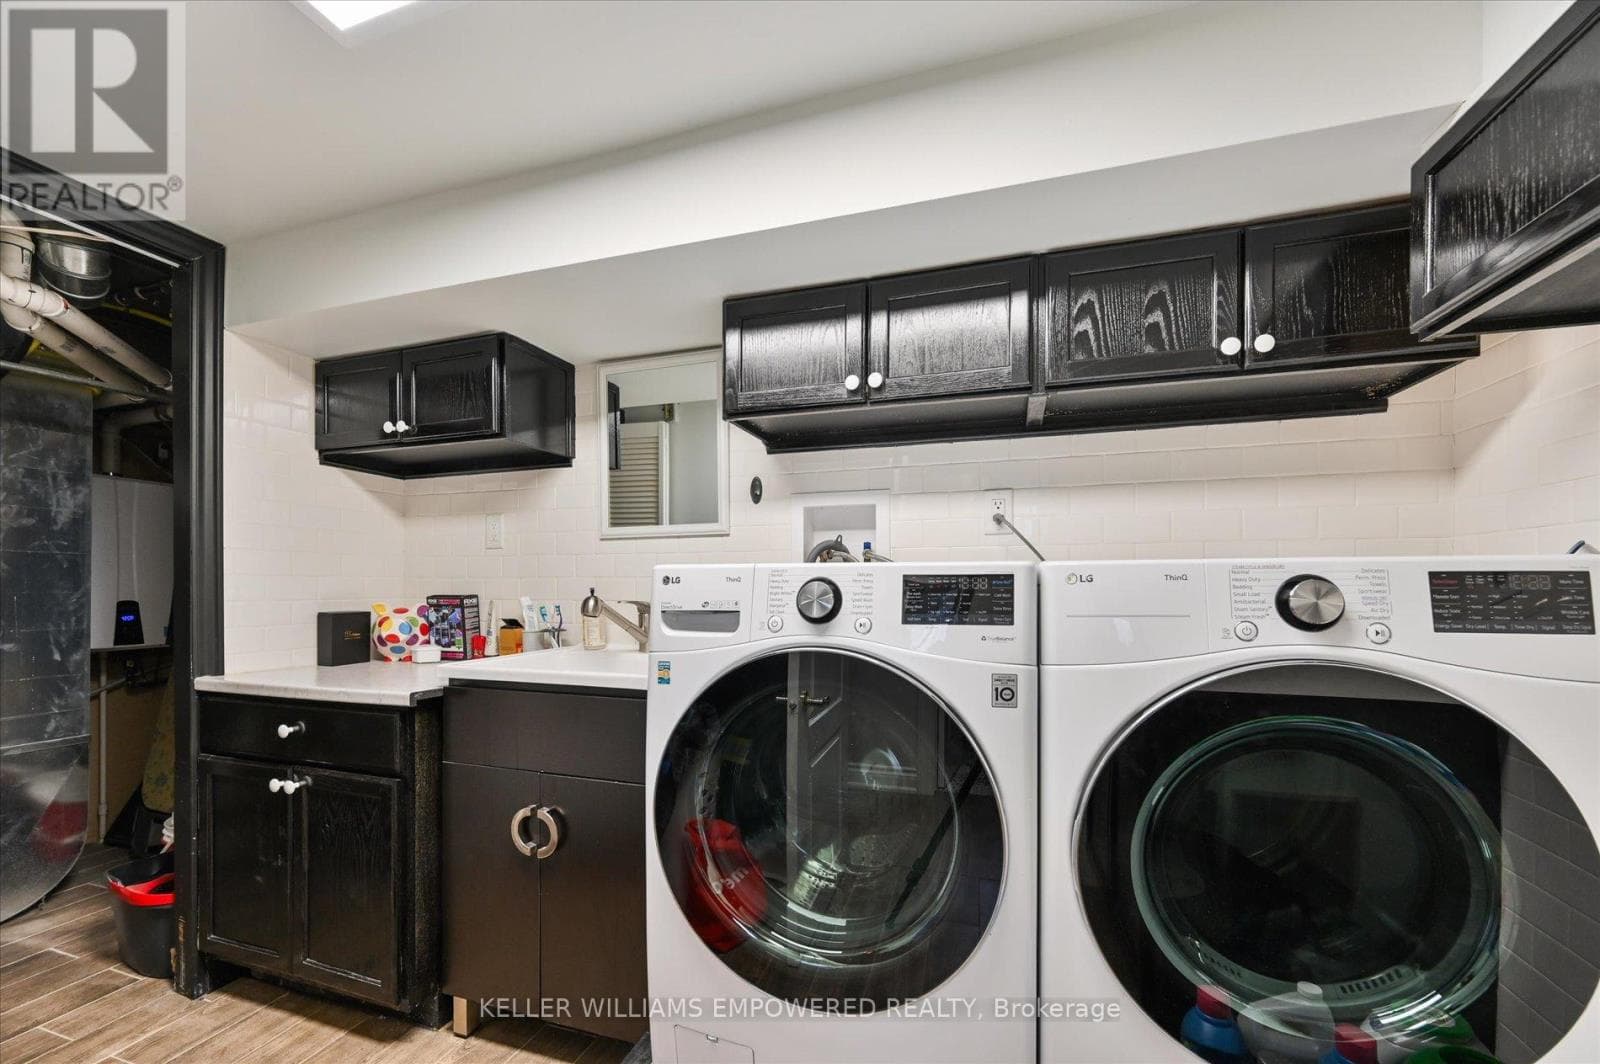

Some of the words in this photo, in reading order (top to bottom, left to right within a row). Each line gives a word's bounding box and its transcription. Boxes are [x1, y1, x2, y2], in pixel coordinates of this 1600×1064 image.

[671, 576, 681, 584] LG
[1079, 574, 1094, 583] LG
[1164, 574, 1188, 582] ThinQ
